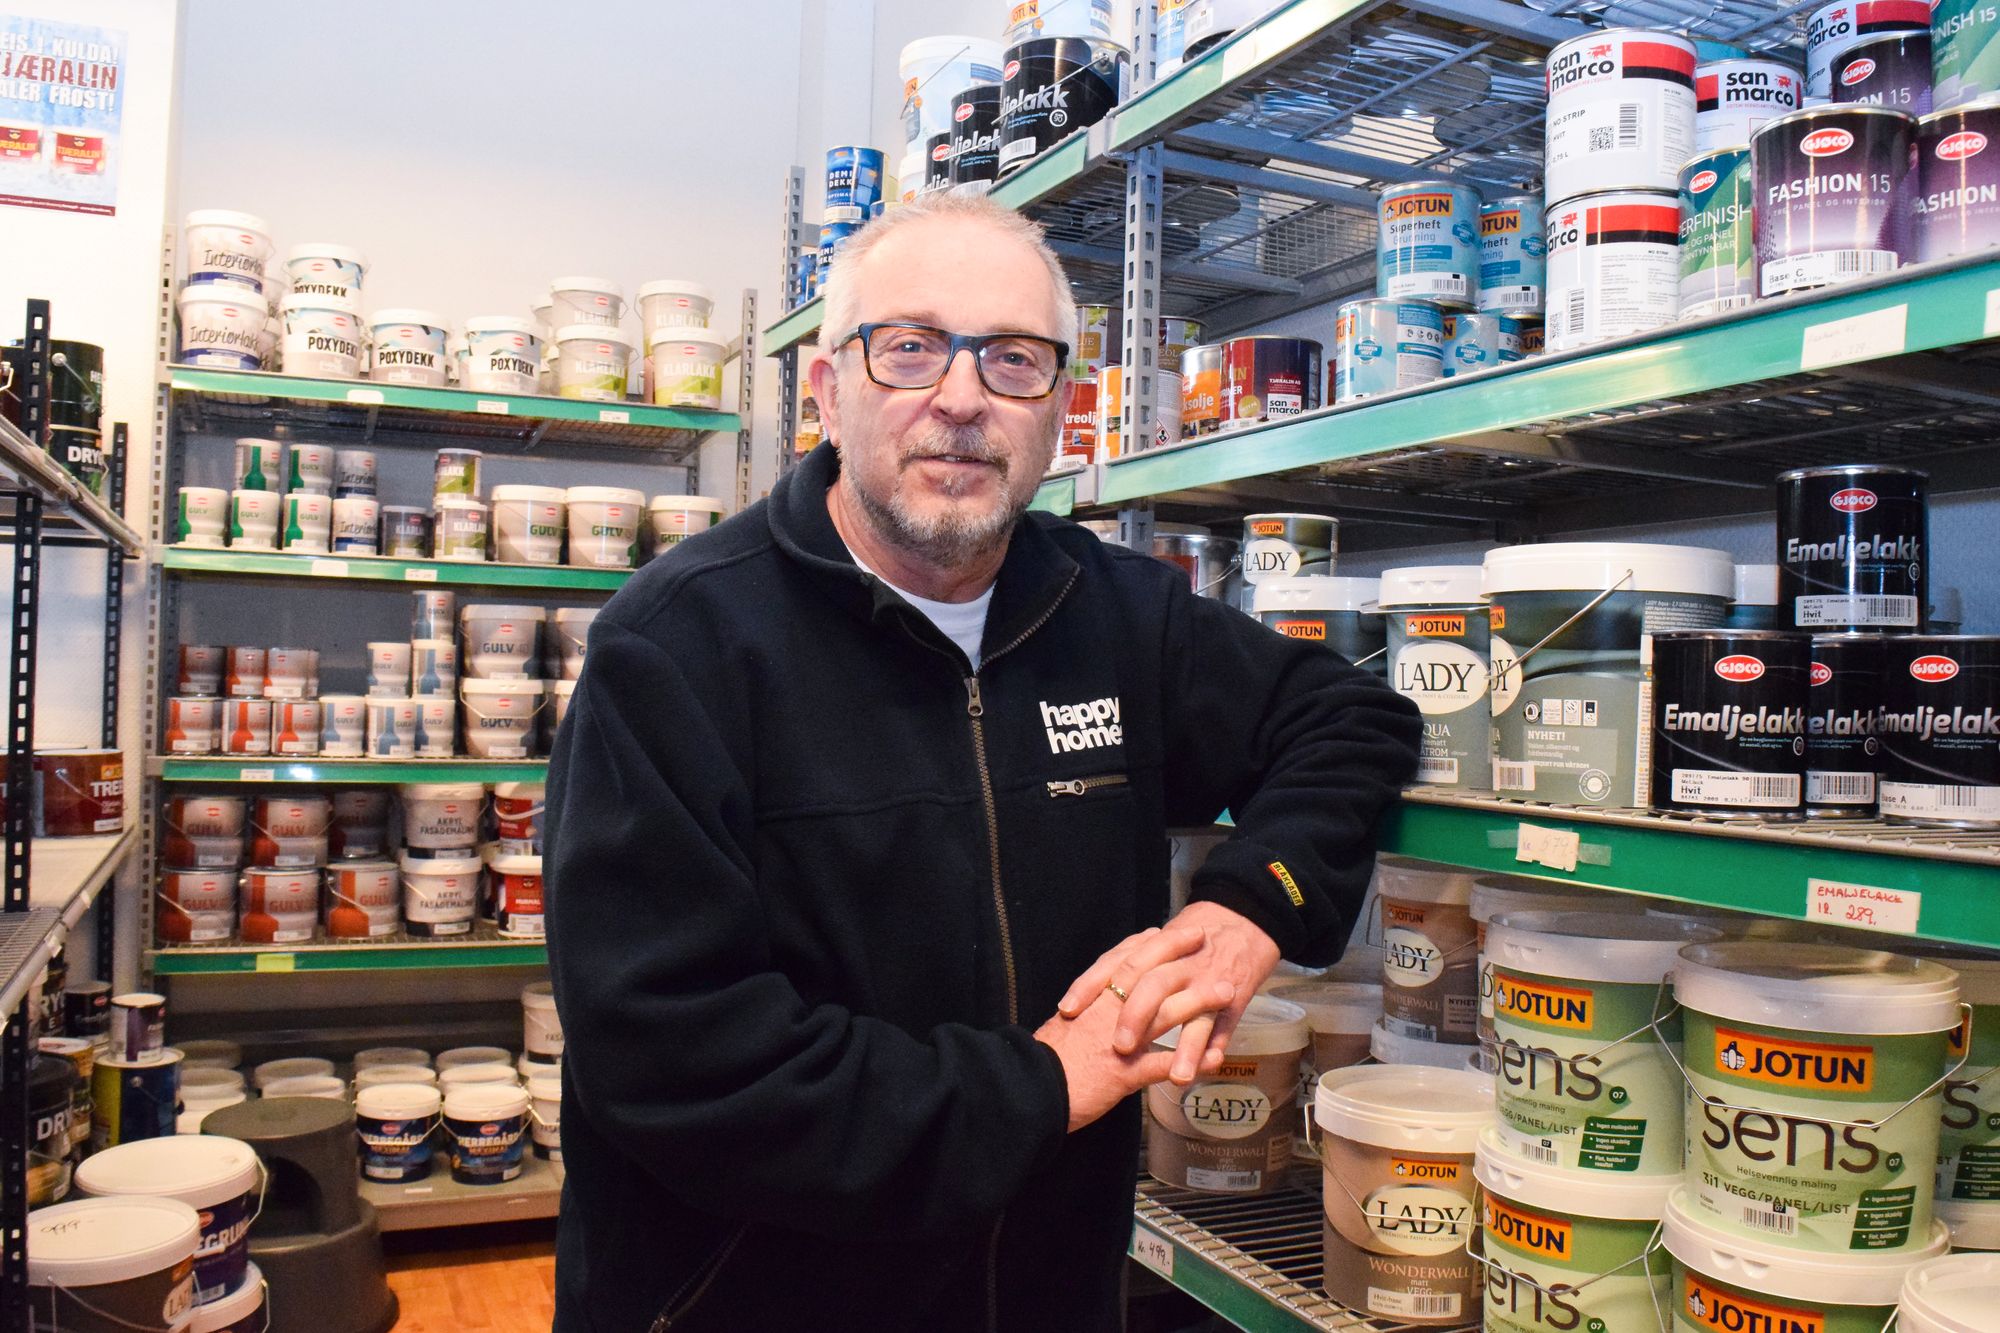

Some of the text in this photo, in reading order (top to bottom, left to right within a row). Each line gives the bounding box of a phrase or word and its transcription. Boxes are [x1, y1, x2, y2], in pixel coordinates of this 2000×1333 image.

[1978, 6, 1997, 23] 15
[53, 36, 119, 65] KULDA!
[1551, 51, 1581, 76] san
[1552, 60, 1615, 92] marco
[1726, 70, 1768, 87] san
[50, 85, 115, 112] FROST!
[1726, 86, 1793, 107] marco
[1563, 109, 1586, 123] STRIP
[1803, 133, 1850, 151] GJØCO
[1938, 136, 1985, 154] GJØCO
[1768, 173, 1892, 206] FASHION 15
[1396, 199, 1451, 217] JOTUN
[1390, 219, 1441, 234] Superheft
[379, 351, 434, 368] POXYDEKK
[490, 357, 535, 377] POXYDEKK
[1269, 407, 1300, 415] marco
[1833, 495, 1875, 506] GJØCO
[1257, 523, 1282, 533] JOTUN
[1786, 533, 1921, 567] Emaljelakk
[1245, 551, 1292, 572] LADY
[1803, 610, 1822, 618] Hvit
[1285, 626, 1323, 638] JOTUN
[1418, 620, 1462, 633] JOTUN
[482, 643, 515, 655] GULV
[1399, 662, 1477, 693] LADY
[1717, 662, 1762, 675] GJØCO
[1912, 663, 1956, 675] GJØCO
[1039, 697, 1120, 727] happy
[1663, 703, 1805, 741] Emaljelakk
[1046, 724, 1123, 754] home
[1680, 785, 1702, 795] Hvit
[1384, 939, 1435, 973] LADY
[1508, 990, 1586, 1024] JOTUN
[1496, 1030, 1603, 1102] ens
[1750, 1046, 1866, 1085] JOTUN
[1611, 1091, 1624, 1100] 07
[1192, 1095, 1265, 1122] LADY
[1702, 1095, 1881, 1174] sens
[1888, 1158, 1901, 1167] 07
[1409, 1165, 1457, 1179] JOTUN
[1702, 1171, 1720, 1189] 3i1
[1736, 1165, 1798, 1187] Helsevennlig
[1800, 1179, 1838, 1193] maling
[1774, 1204, 1784, 1212] 07
[1377, 1199, 1468, 1236] LADY
[1493, 1211, 1565, 1254] JOTUN
[1369, 1256, 1470, 1279] WONDERWALL
[1407, 1286, 1433, 1296] VEGG
[1410, 1279, 1429, 1287] matt
[1484, 1256, 1581, 1330] ens
[1708, 1297, 1817, 1333] JOTUN
[1590, 1322, 1602, 1330] 07
